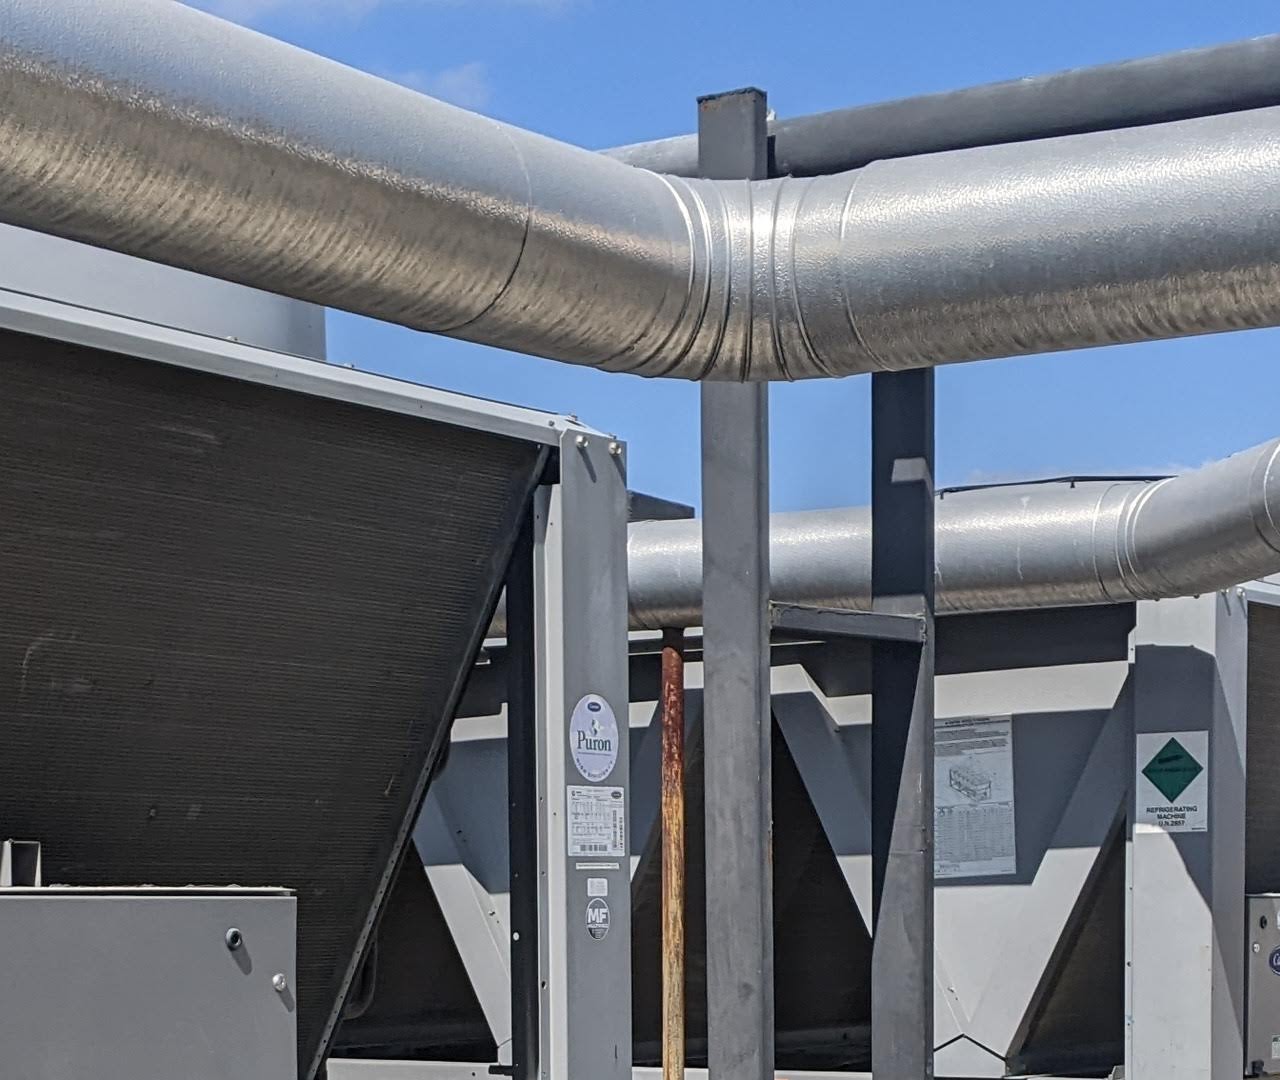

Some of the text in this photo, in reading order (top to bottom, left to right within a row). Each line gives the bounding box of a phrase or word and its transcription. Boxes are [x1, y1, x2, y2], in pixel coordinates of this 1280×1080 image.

[577, 729, 612, 752] Puron
[1146, 805, 1198, 813] REFRIGERATING
[588, 908, 608, 923] MF
